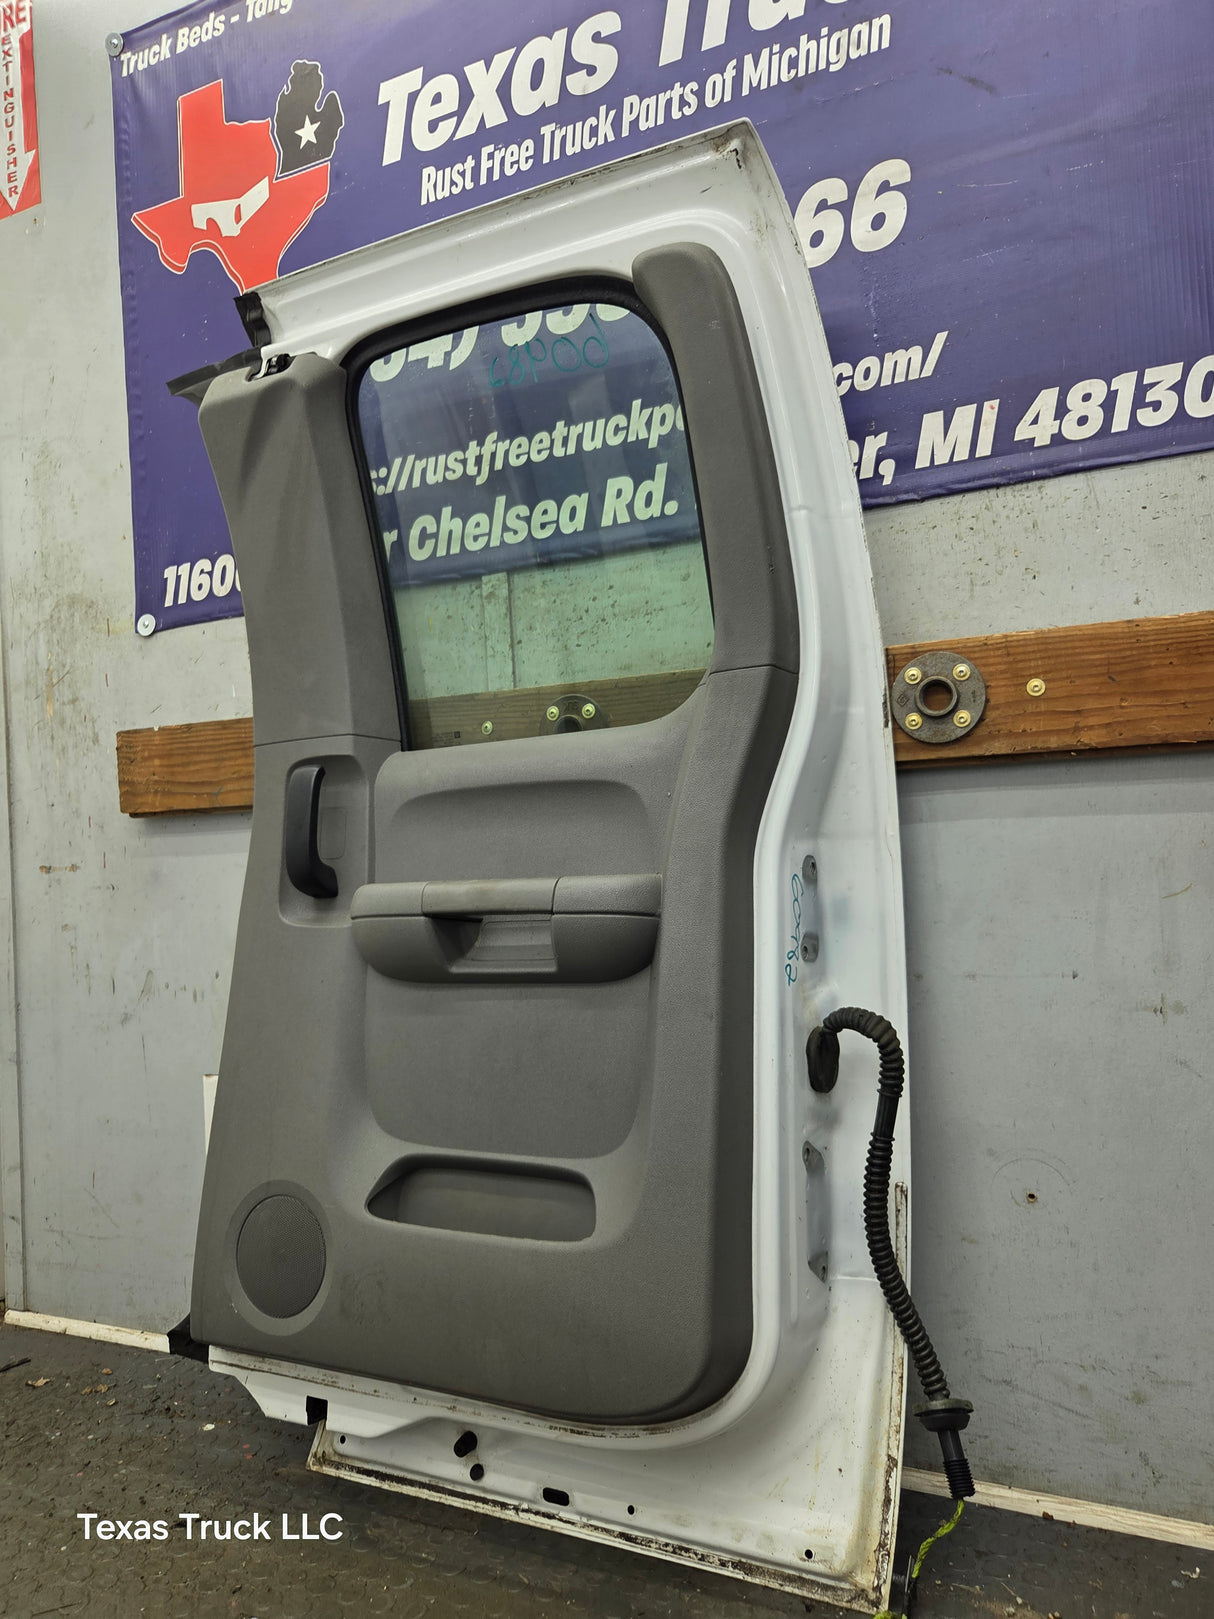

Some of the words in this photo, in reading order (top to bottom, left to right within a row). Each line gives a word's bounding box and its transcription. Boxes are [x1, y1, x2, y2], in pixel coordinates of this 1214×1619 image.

[1, 33, 18, 198] EXTINGUISHER
[120, 34, 172, 77] Truck
[176, 12, 225, 53] Beds
[378, 11, 622, 167] Texas
[420, 155, 475, 206] Rust
[480, 139, 534, 186] Free
[540, 105, 616, 163] Truck
[622, 80, 699, 138] Parts
[705, 58, 737, 108] of
[742, 14, 892, 97] Michigan
[794, 158, 912, 269] 66
[408, 493, 588, 561] Chelsea
[601, 462, 679, 528] Rd.
[915, 398, 1000, 469] MI
[1014, 354, 1214, 448] 48130
